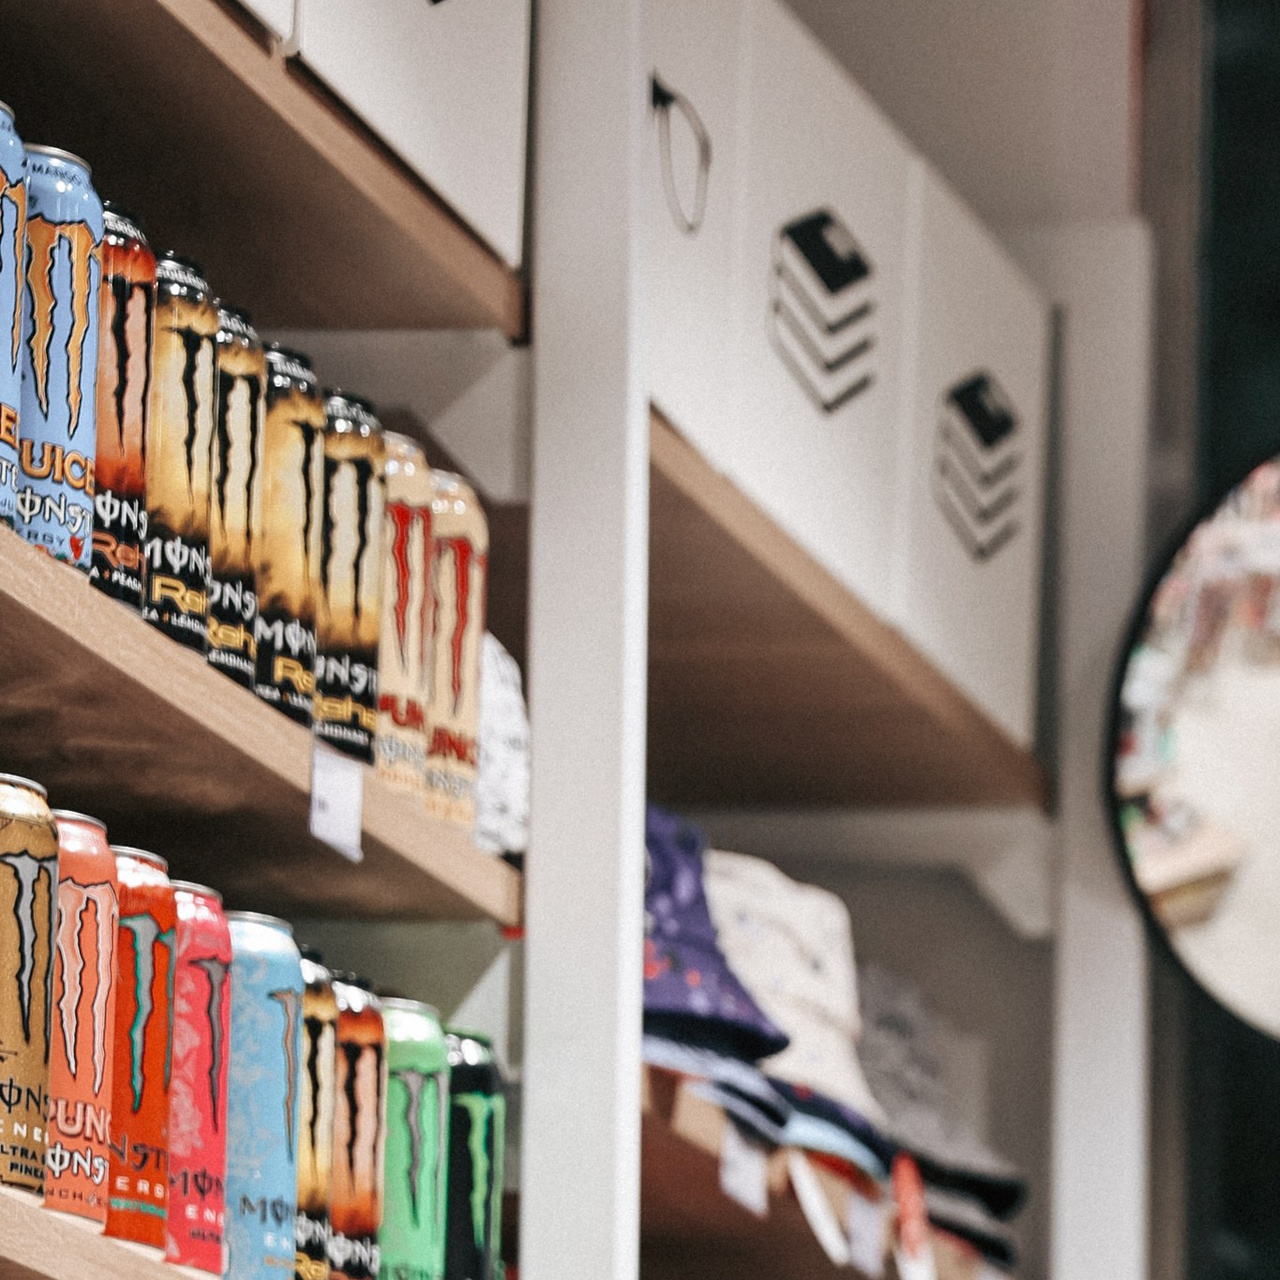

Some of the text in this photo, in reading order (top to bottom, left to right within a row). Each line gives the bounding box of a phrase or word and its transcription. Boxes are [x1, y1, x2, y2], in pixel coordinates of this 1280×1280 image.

[20, 437, 95, 497] UICE
[1, 1144, 38, 1162] LTRA
[47, 1141, 109, 1185] ONS
[115, 1175, 165, 1199] ERG
